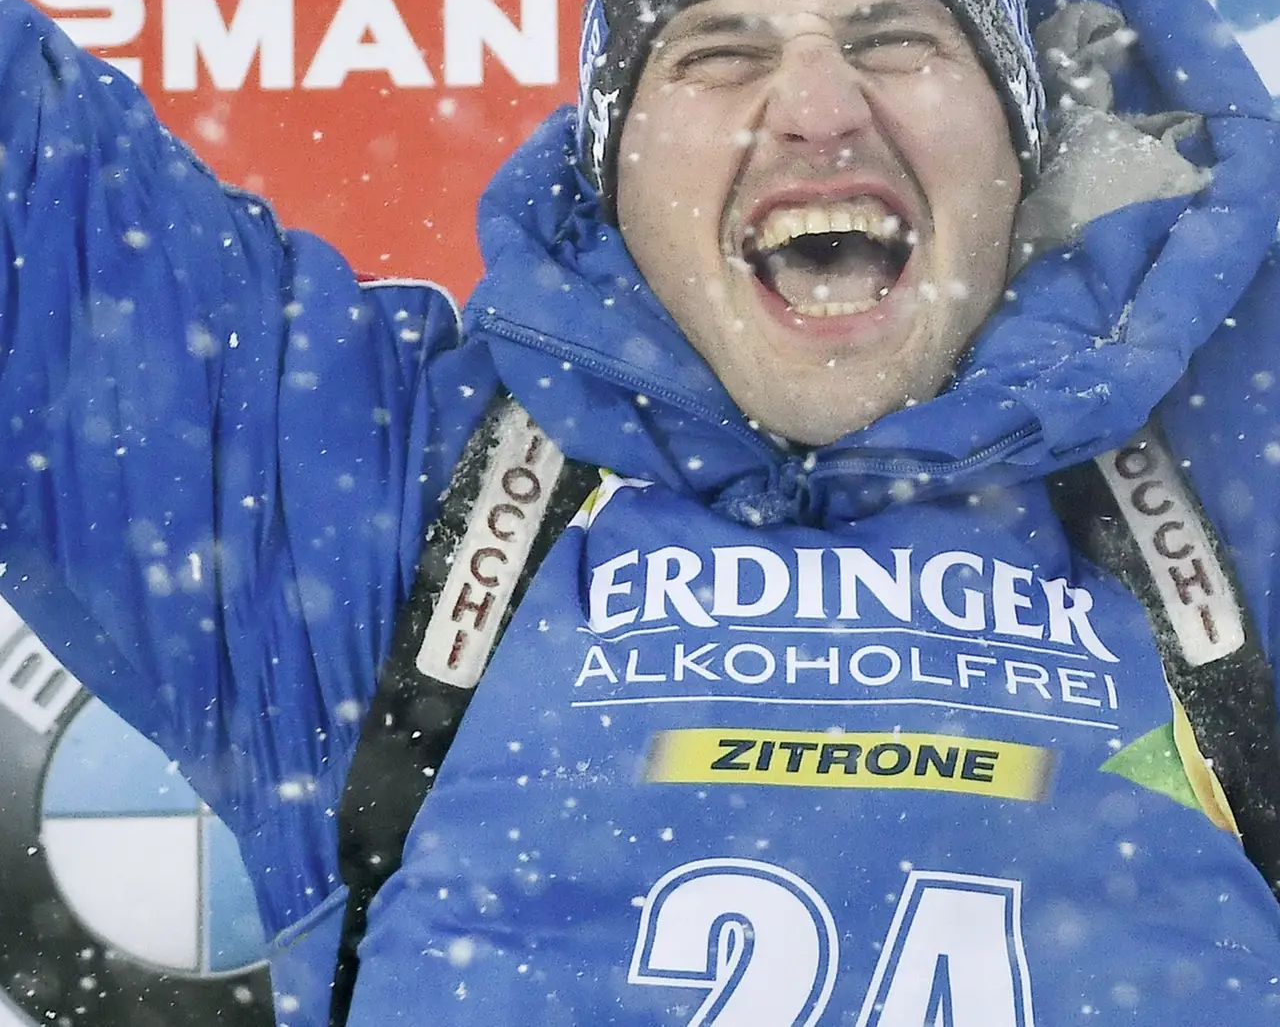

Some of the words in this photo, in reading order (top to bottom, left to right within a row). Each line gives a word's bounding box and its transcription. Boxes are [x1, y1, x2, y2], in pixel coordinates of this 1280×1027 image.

[447, 421, 542, 671] IOCCHI
[584, 544, 1121, 663] ERDINGER
[574, 641, 1121, 710] ALKOHOLFREI
[708, 737, 1000, 785] ZITRONE
[627, 857, 1036, 1027] 24
